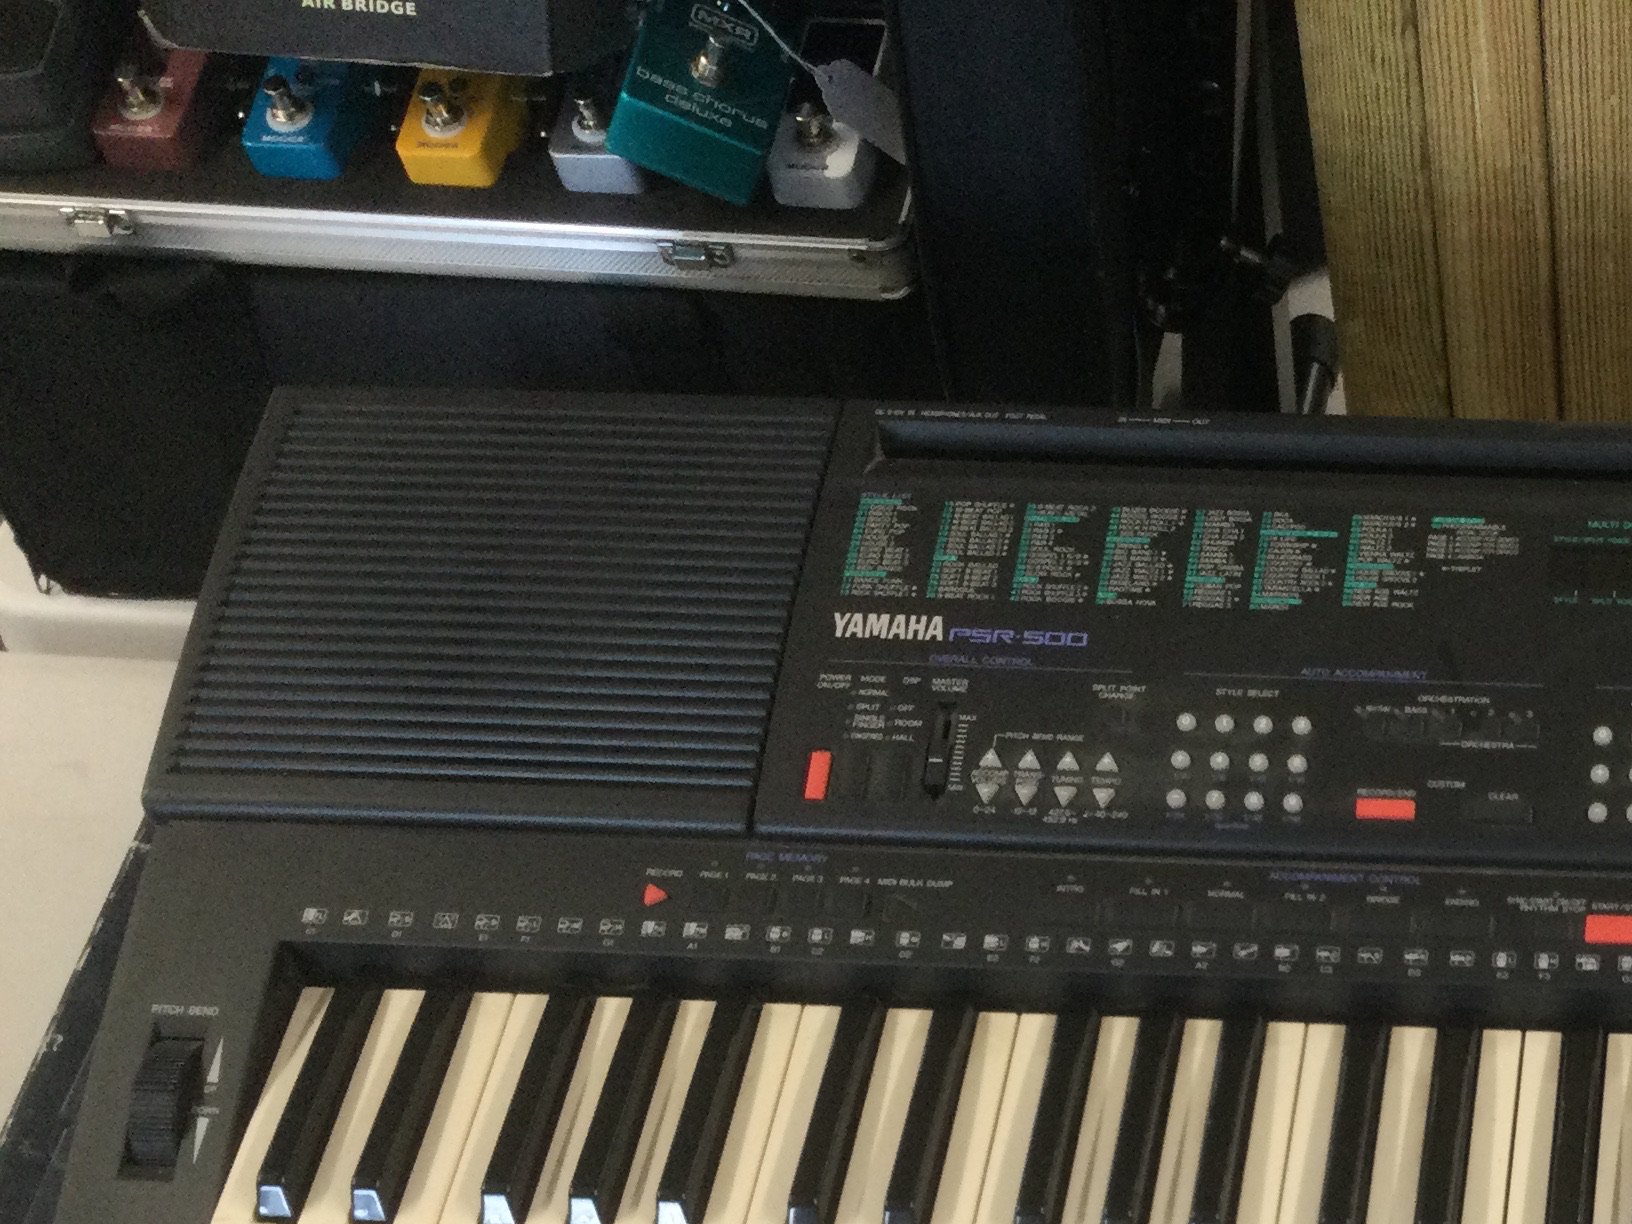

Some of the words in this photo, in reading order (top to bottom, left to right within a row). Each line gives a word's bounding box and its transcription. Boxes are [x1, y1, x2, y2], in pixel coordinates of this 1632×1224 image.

[302, 0, 336, 9] AIR
[341, 0, 417, 16] BRIDGE
[697, 9, 751, 40] MXR
[636, 66, 689, 96] bass
[693, 91, 769, 130] chorus
[664, 93, 732, 128] deluxe
[834, 612, 943, 641] YAMAHA
[949, 627, 1088, 646] PSR-500
[981, 656, 1033, 666] CONTROL
[819, 674, 852, 682] POWER
[860, 675, 886, 683] MODE
[932, 678, 969, 686] MASTER
[1092, 684, 1117, 692] SPLIT
[1216, 688, 1245, 696] STYLE
[1248, 689, 1280, 698] SELECT
[1057, 734, 1084, 742] RANGE
[1426, 780, 1466, 788] CUSTOM
[1488, 792, 1519, 800] CLEAR
[840, 876, 863, 884] PAGE
[1208, 889, 1244, 899] NORMAL
[151, 1004, 184, 1016] PITCH
[188, 1005, 219, 1016] BEND
